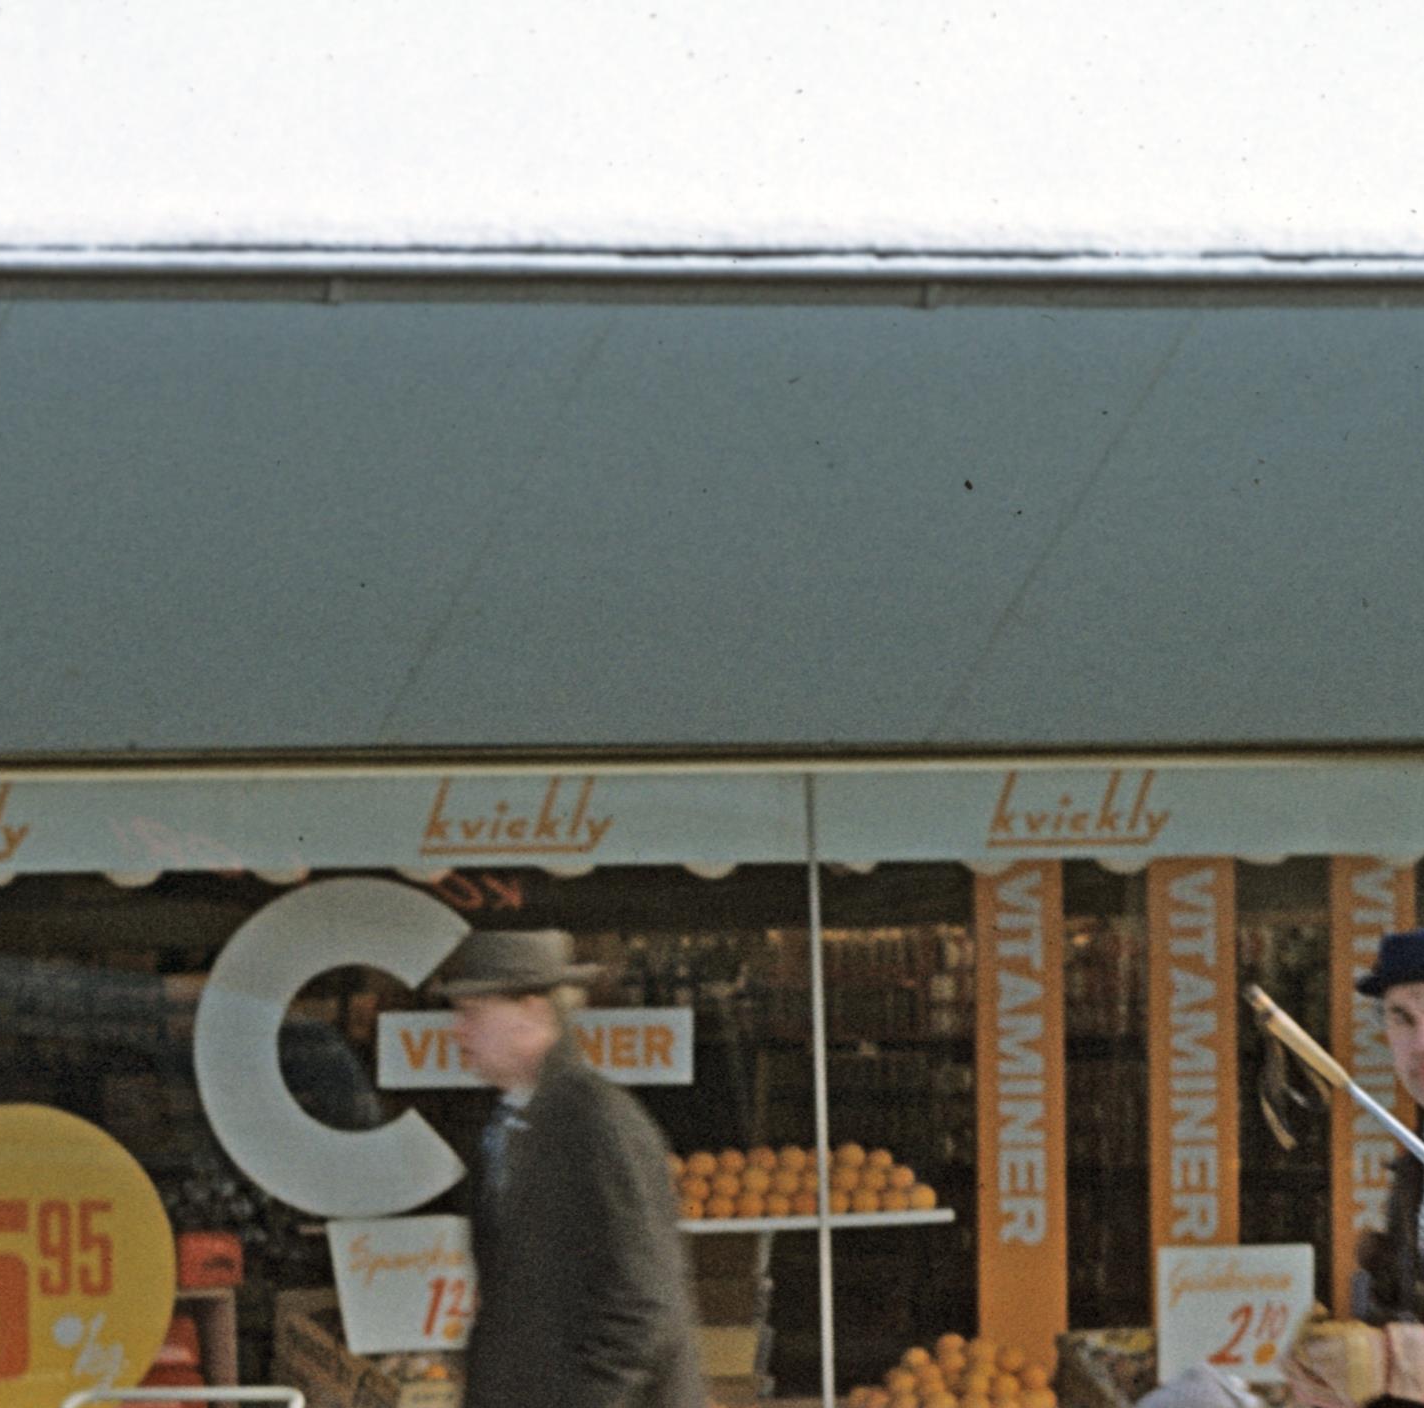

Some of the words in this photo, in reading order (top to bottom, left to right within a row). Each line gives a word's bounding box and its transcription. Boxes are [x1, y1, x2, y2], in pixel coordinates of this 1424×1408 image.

[419, 776, 613, 856] kvickly
[987, 769, 1172, 848] kvickly
[194, 876, 473, 1218] C
[399, 1023, 675, 1071] VITNER
[996, 870, 1047, 1244] VITAMINER
[1168, 868, 1219, 1239] VITAMINER
[1351, 866, 1397, 1232] VITMINER
